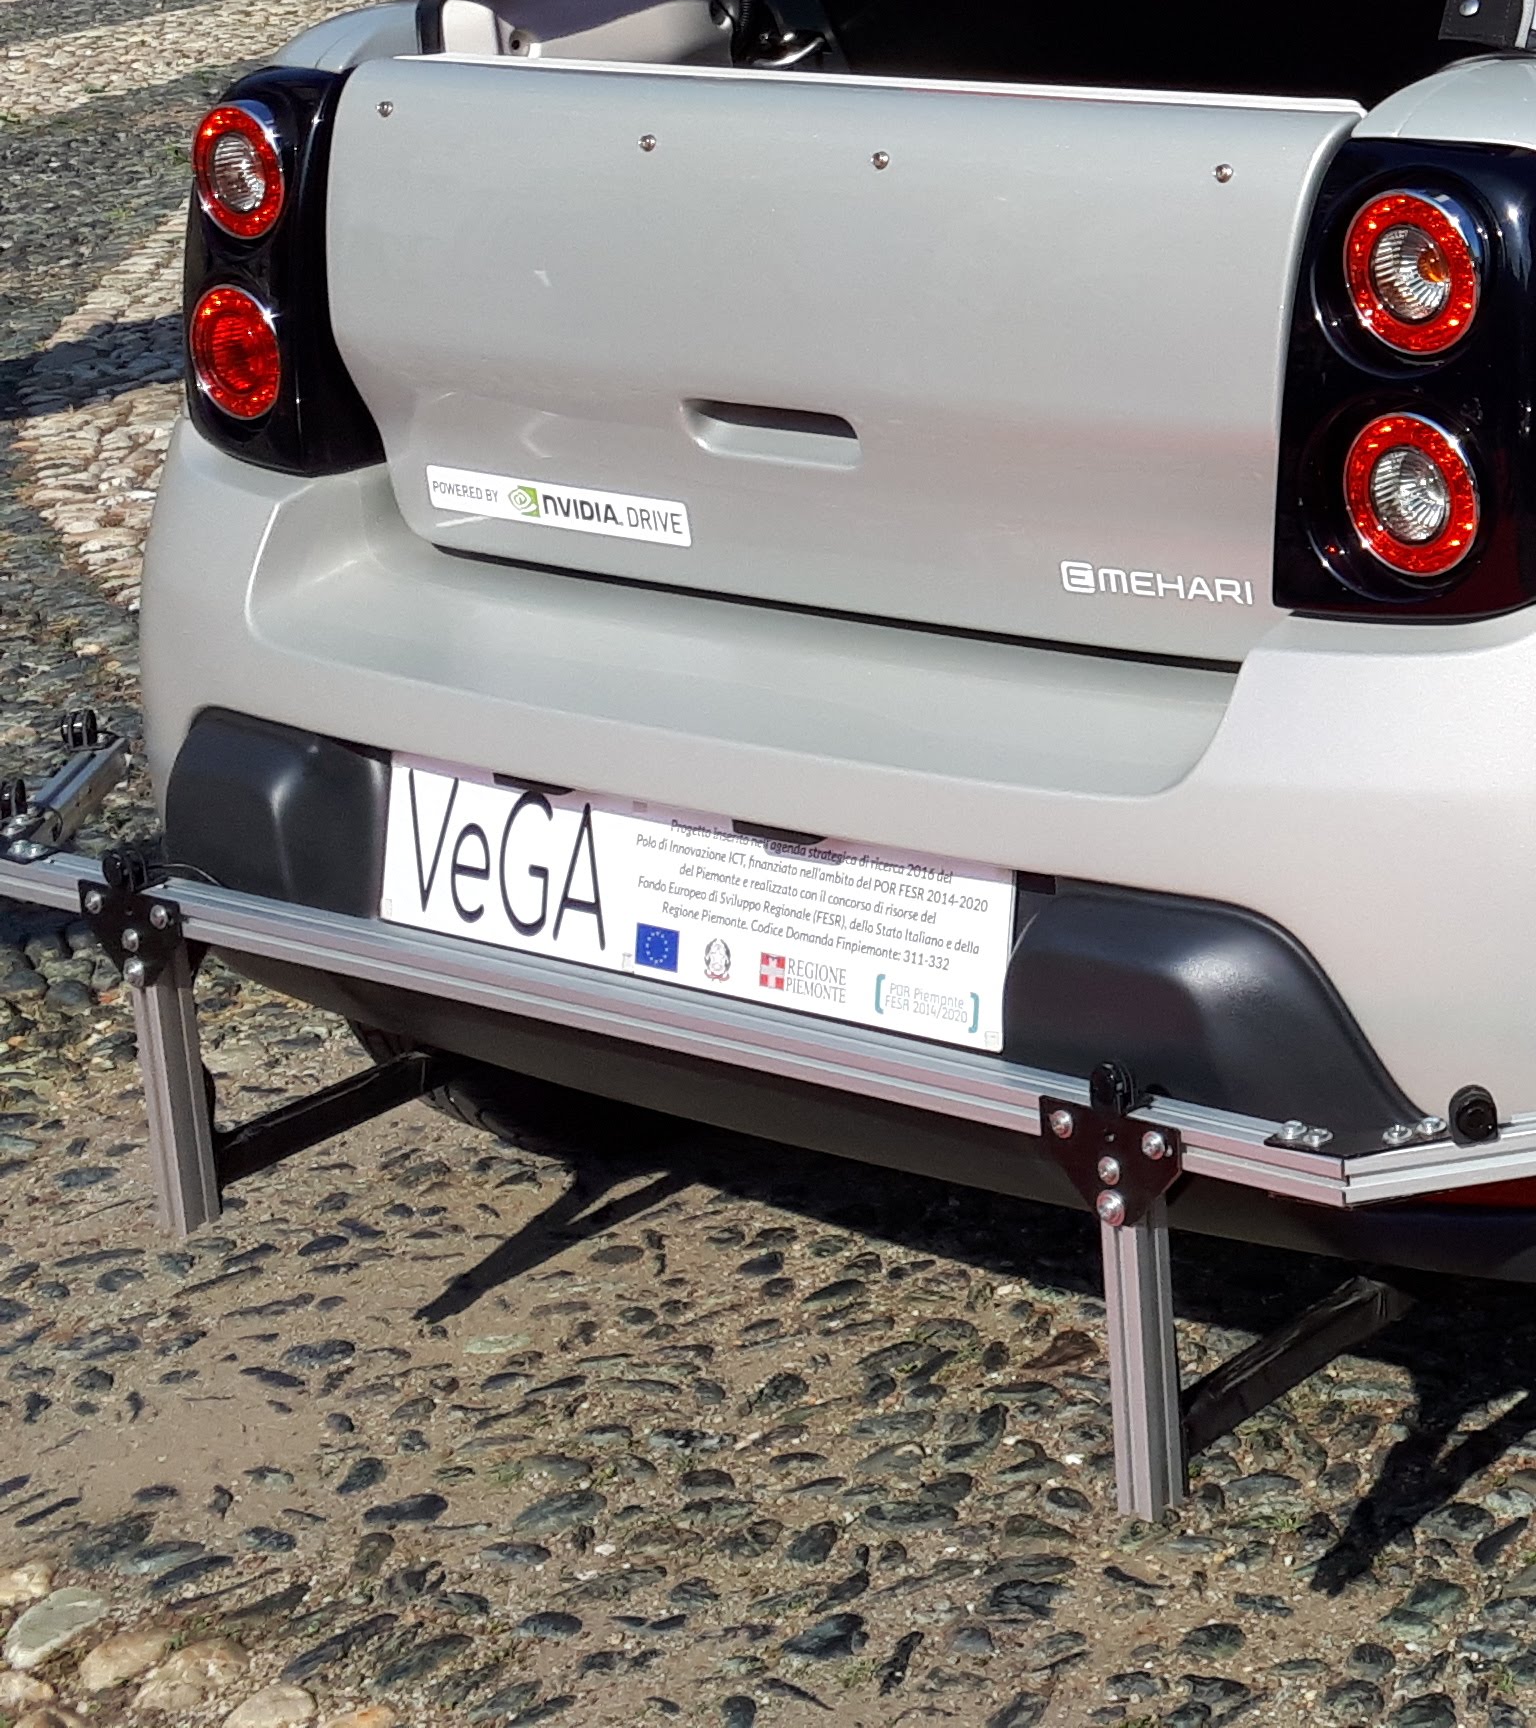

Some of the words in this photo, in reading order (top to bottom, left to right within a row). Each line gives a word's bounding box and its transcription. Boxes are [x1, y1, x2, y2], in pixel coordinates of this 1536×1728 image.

[432, 480, 483, 500] POWERED
[485, 489, 499, 502] BY
[542, 494, 619, 523] NVIDIA
[626, 506, 683, 535] DRIVE
[408, 765, 606, 951] VeGA
[636, 833, 657, 849] Polo
[658, 837, 668, 851] di
[669, 839, 726, 862] Innovazione
[728, 850, 746, 869] ICT,
[748, 855, 798, 875] finanziato
[799, 866, 855, 887] nell'ambito
[856, 877, 872, 890] del
[874, 879, 896, 895] POR
[898, 883, 924, 901] FESR
[926, 889, 989, 913] 2014-2020
[671, 819, 711, 839] Progetto
[713, 827, 749, 845] inserito
[808, 846, 856, 866] strategica
[858, 853, 869, 867] di
[871, 857, 904, 874] ricerca
[906, 862, 935, 881] 2016
[936, 870, 953, 884] del
[638, 876, 667, 893] Fondo
[668, 882, 707, 901] Europeo
[708, 890, 718, 903] di
[719, 892, 761, 912] Sviluppo
[763, 900, 811, 922] Regionale
[812, 909, 847, 931] (FESR),
[849, 917, 874, 934] dello
[875, 922, 903, 939] Stato
[904, 928, 944, 948] Italiano
[946, 939, 953, 950] e
[953, 938, 980, 955] della
[679, 863, 694, 876] del
[696, 866, 741, 886] Piemonte
[742, 877, 749, 888] e
[750, 879, 798, 897] realizzato
[800, 889, 817, 901] con
[819, 888, 827, 903] il
[827, 893, 871, 912] concorso
[873, 900, 884, 914] di
[885, 902, 919, 921] risorse
[920, 911, 937, 925] del
[662, 901, 699, 920] Regione
[701, 909, 749, 930] Piemonte.
[750, 919, 784, 937] Codice
[785, 926, 834, 947] Domanda
[835, 936, 901, 961] Finpiemonte:
[902, 949, 950, 971] 311-332
[786, 977, 847, 1004] PIEMONTE
[787, 957, 847, 986] REGIONE
[890, 982, 911, 997] POR
[914, 987, 965, 1010] Piemonte
[885, 994, 910, 1009] FESR
[913, 1000, 968, 1023] 2014/2020
